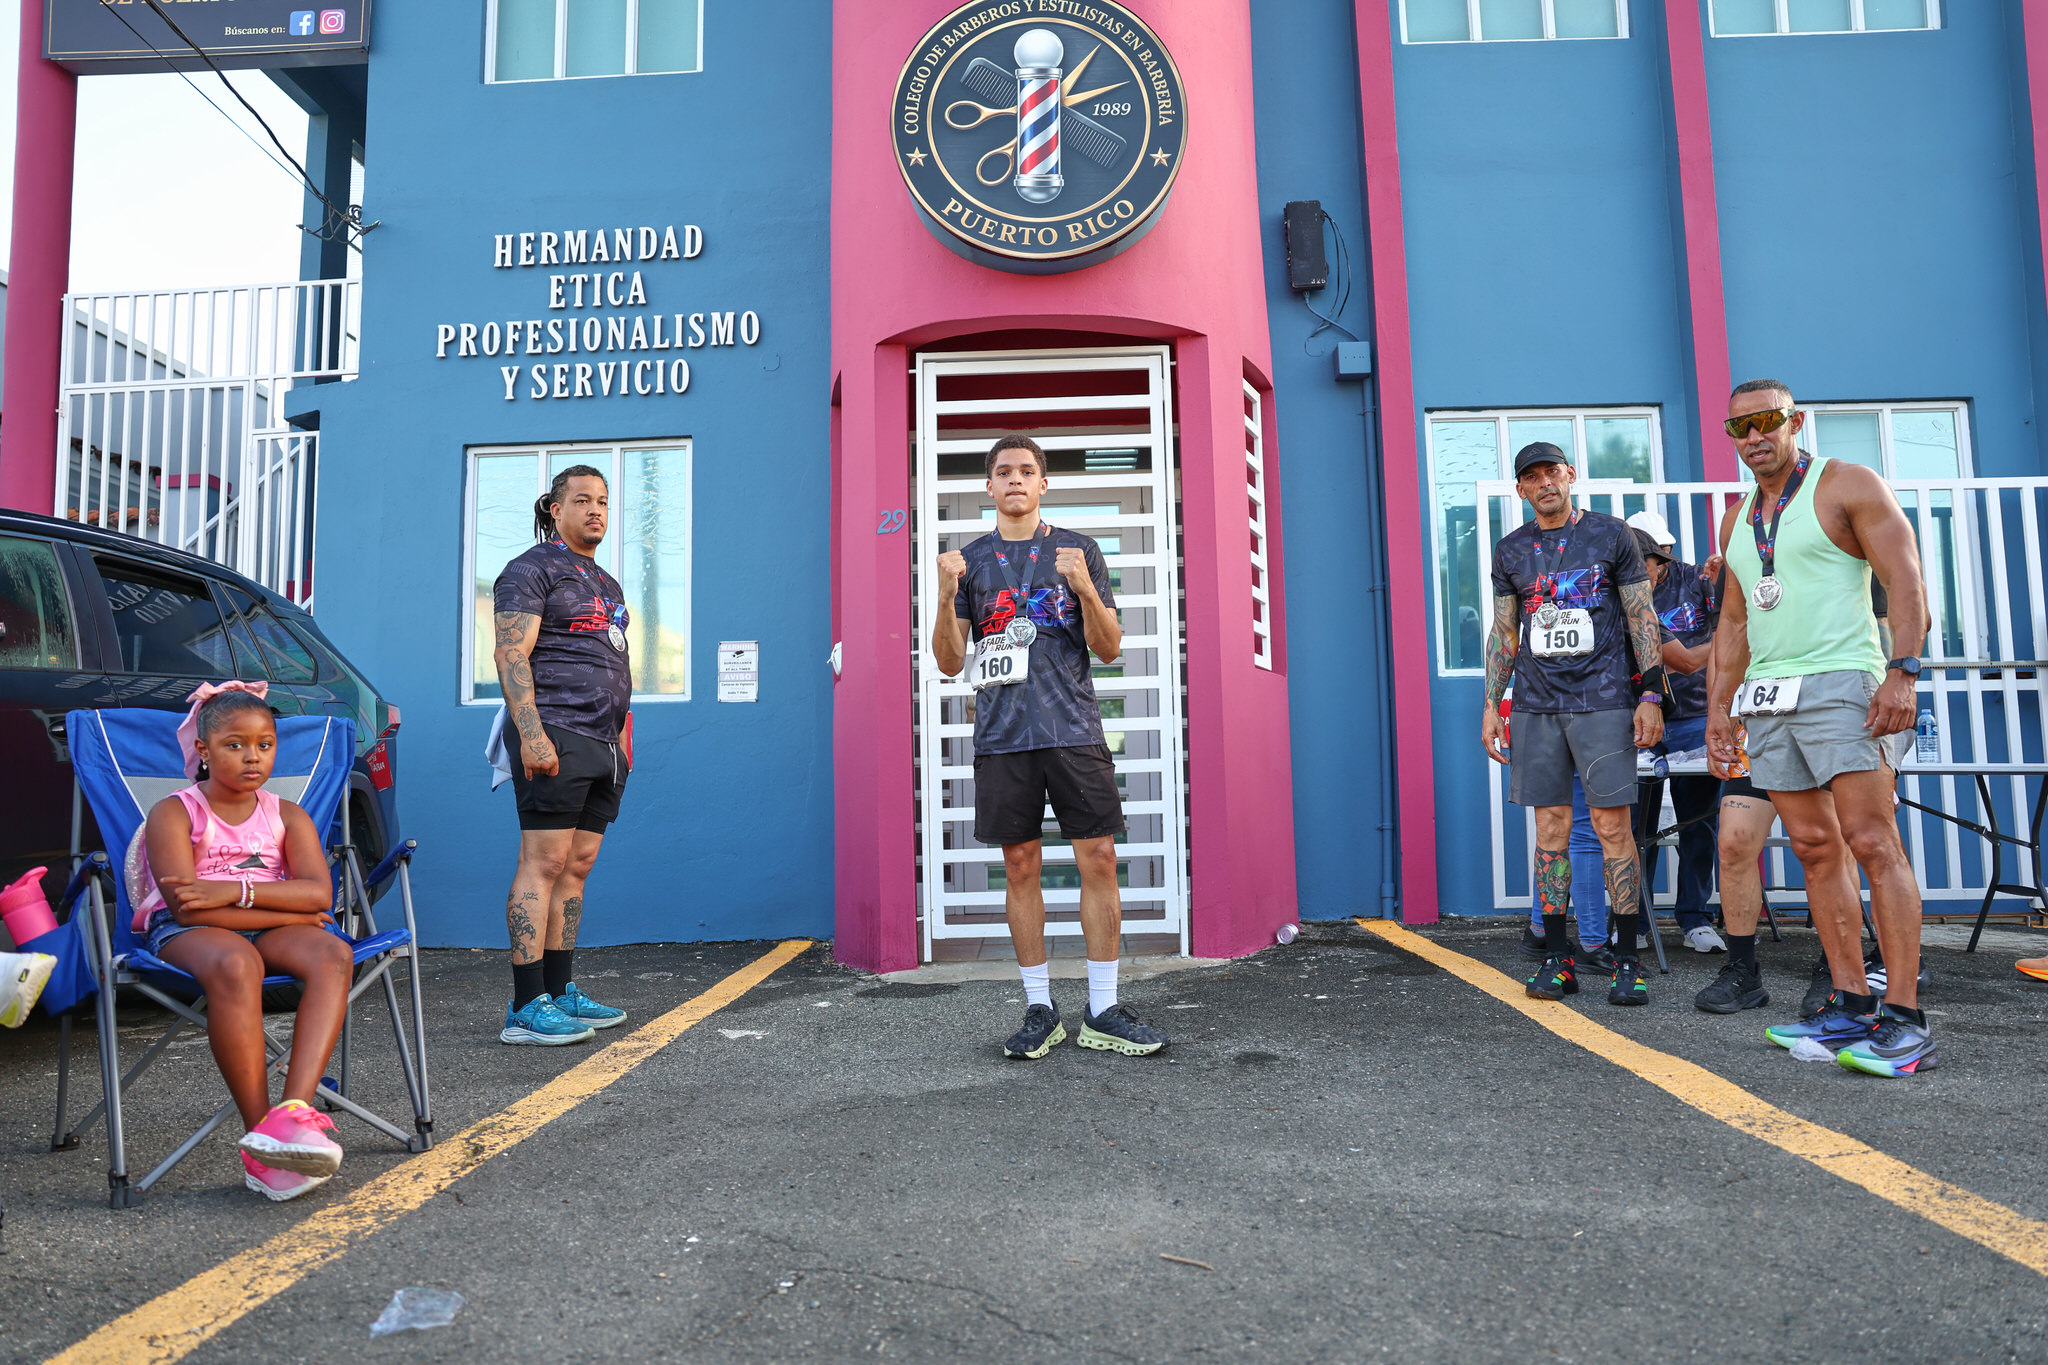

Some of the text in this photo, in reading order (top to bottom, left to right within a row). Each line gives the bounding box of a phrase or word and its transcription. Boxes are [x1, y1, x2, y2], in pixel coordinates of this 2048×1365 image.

[224, 26, 269, 36] Búscanos
[903, 0, 1176, 135] COLEGIO DE BARBEROS Y ESTILISTAS EN BARBERÍA
[1092, 102, 1132, 116] 1989
[940, 197, 1135, 246] PUERTO RICO
[493, 224, 704, 268] HERMANDAD
[548, 270, 648, 309] ETICA
[435, 309, 761, 358] PROFESIONALISMO
[501, 358, 691, 400] Y SERVICIO
[876, 508, 907, 535] 29
[1560, 617, 1580, 626] RUN
[987, 636, 1006, 647] FADE
[995, 643, 1014, 652] RUN
[1543, 629, 1580, 649] 150
[979, 655, 1013, 680] 160
[1753, 685, 1780, 707] 64
